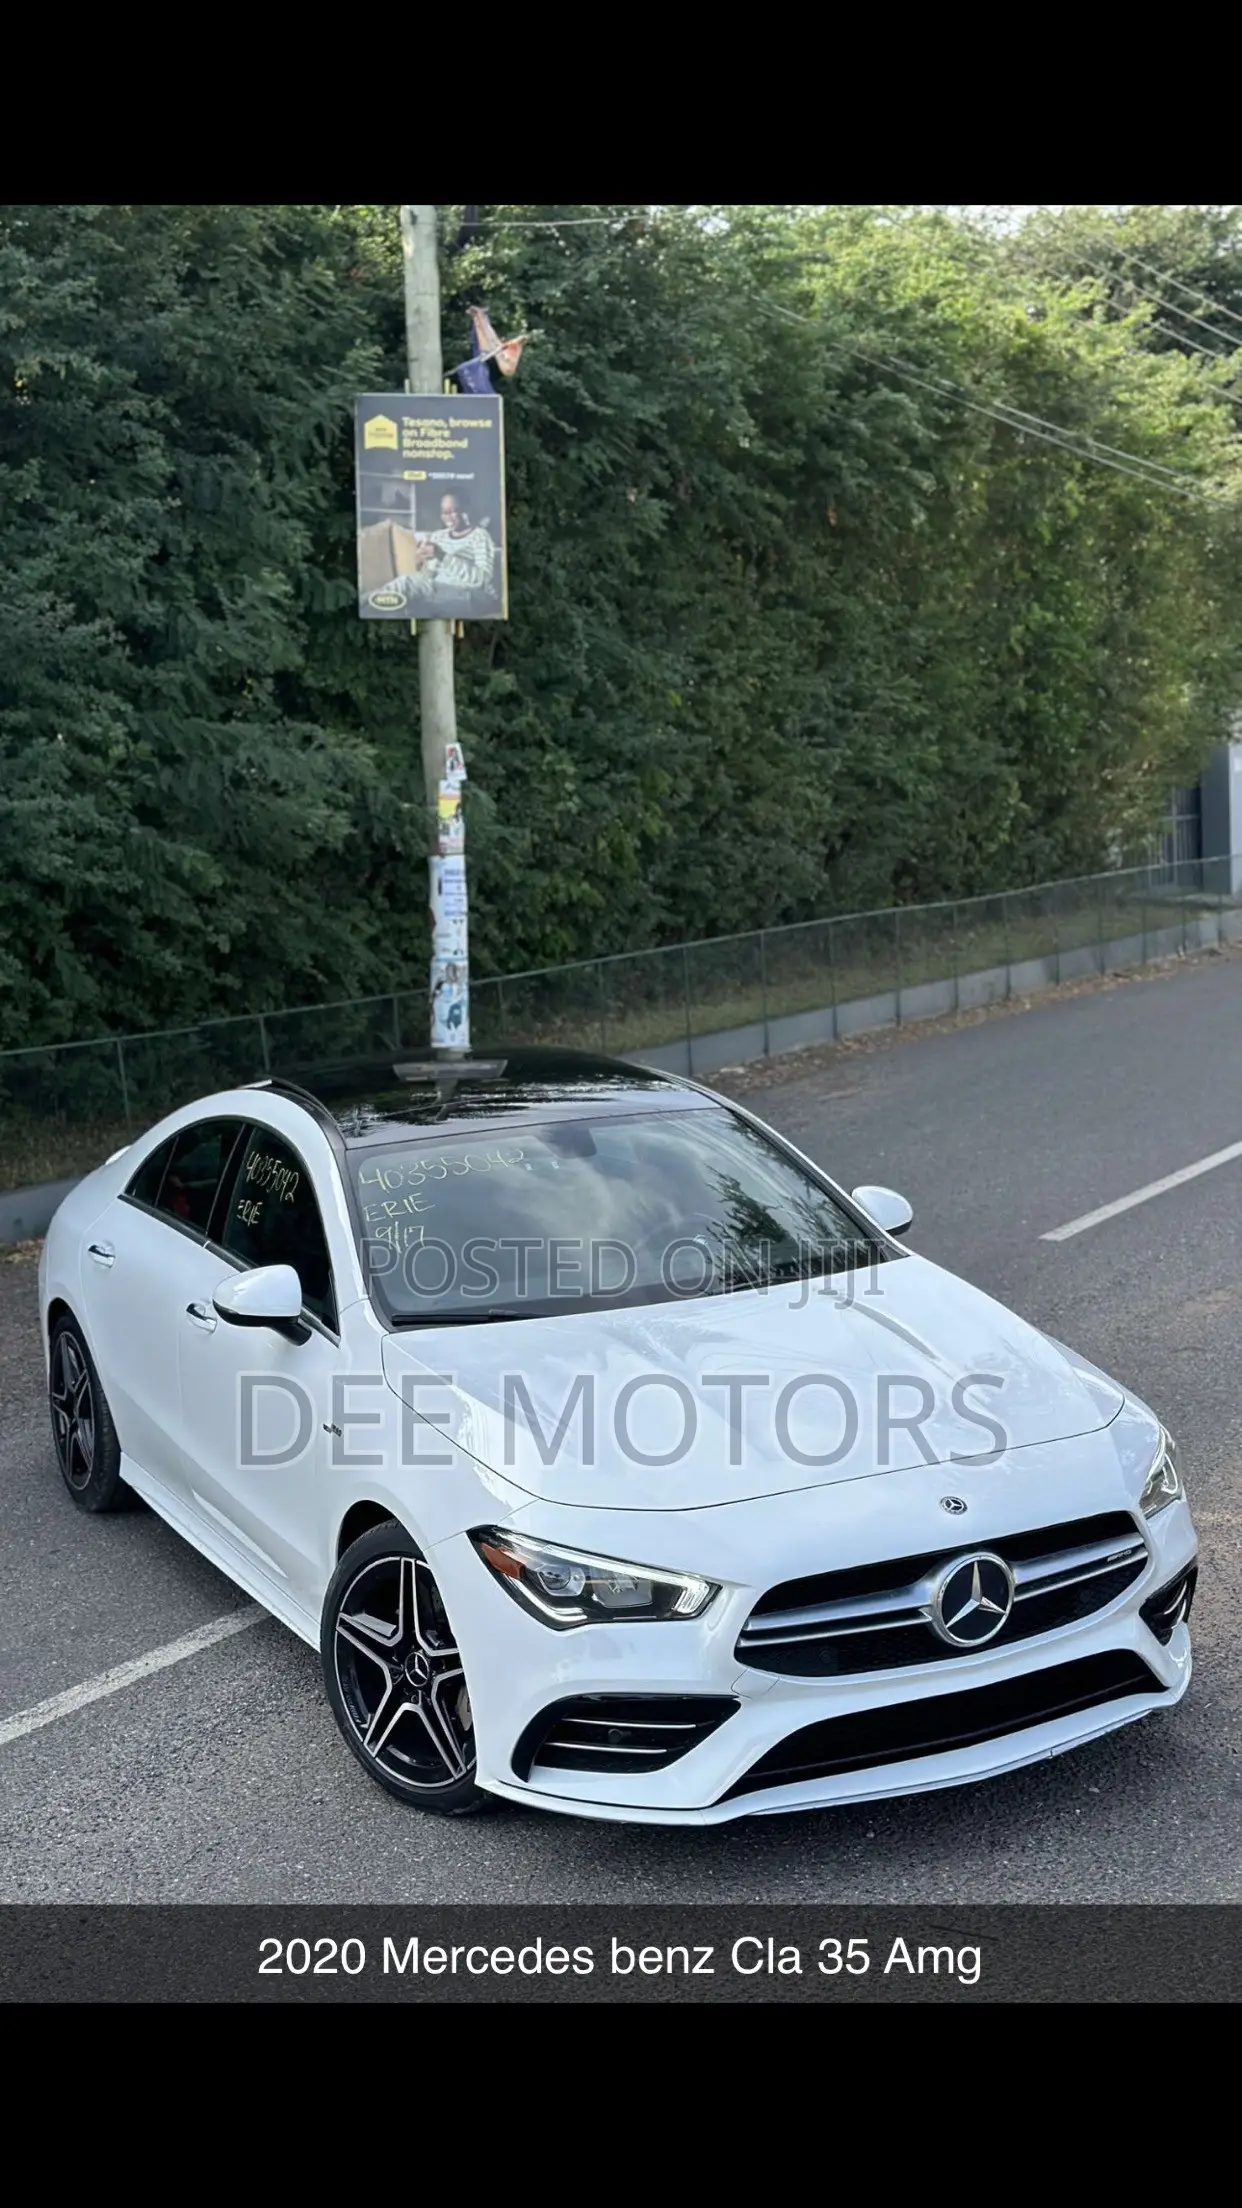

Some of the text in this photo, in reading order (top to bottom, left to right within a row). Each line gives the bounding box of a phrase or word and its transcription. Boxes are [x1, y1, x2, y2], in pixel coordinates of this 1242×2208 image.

[401, 416, 493, 429] Tesano, browse
[402, 428, 418, 438] on
[420, 427, 451, 439] Fibre
[402, 437, 469, 449] Broadband
[402, 448, 455, 461] nonstop.
[245, 1150, 300, 1203] 40355042
[358, 1147, 525, 1194] 40355042
[236, 1198, 263, 1227] ERIE
[363, 1192, 436, 1223] ERIE
[374, 1220, 427, 1254] 9/17
